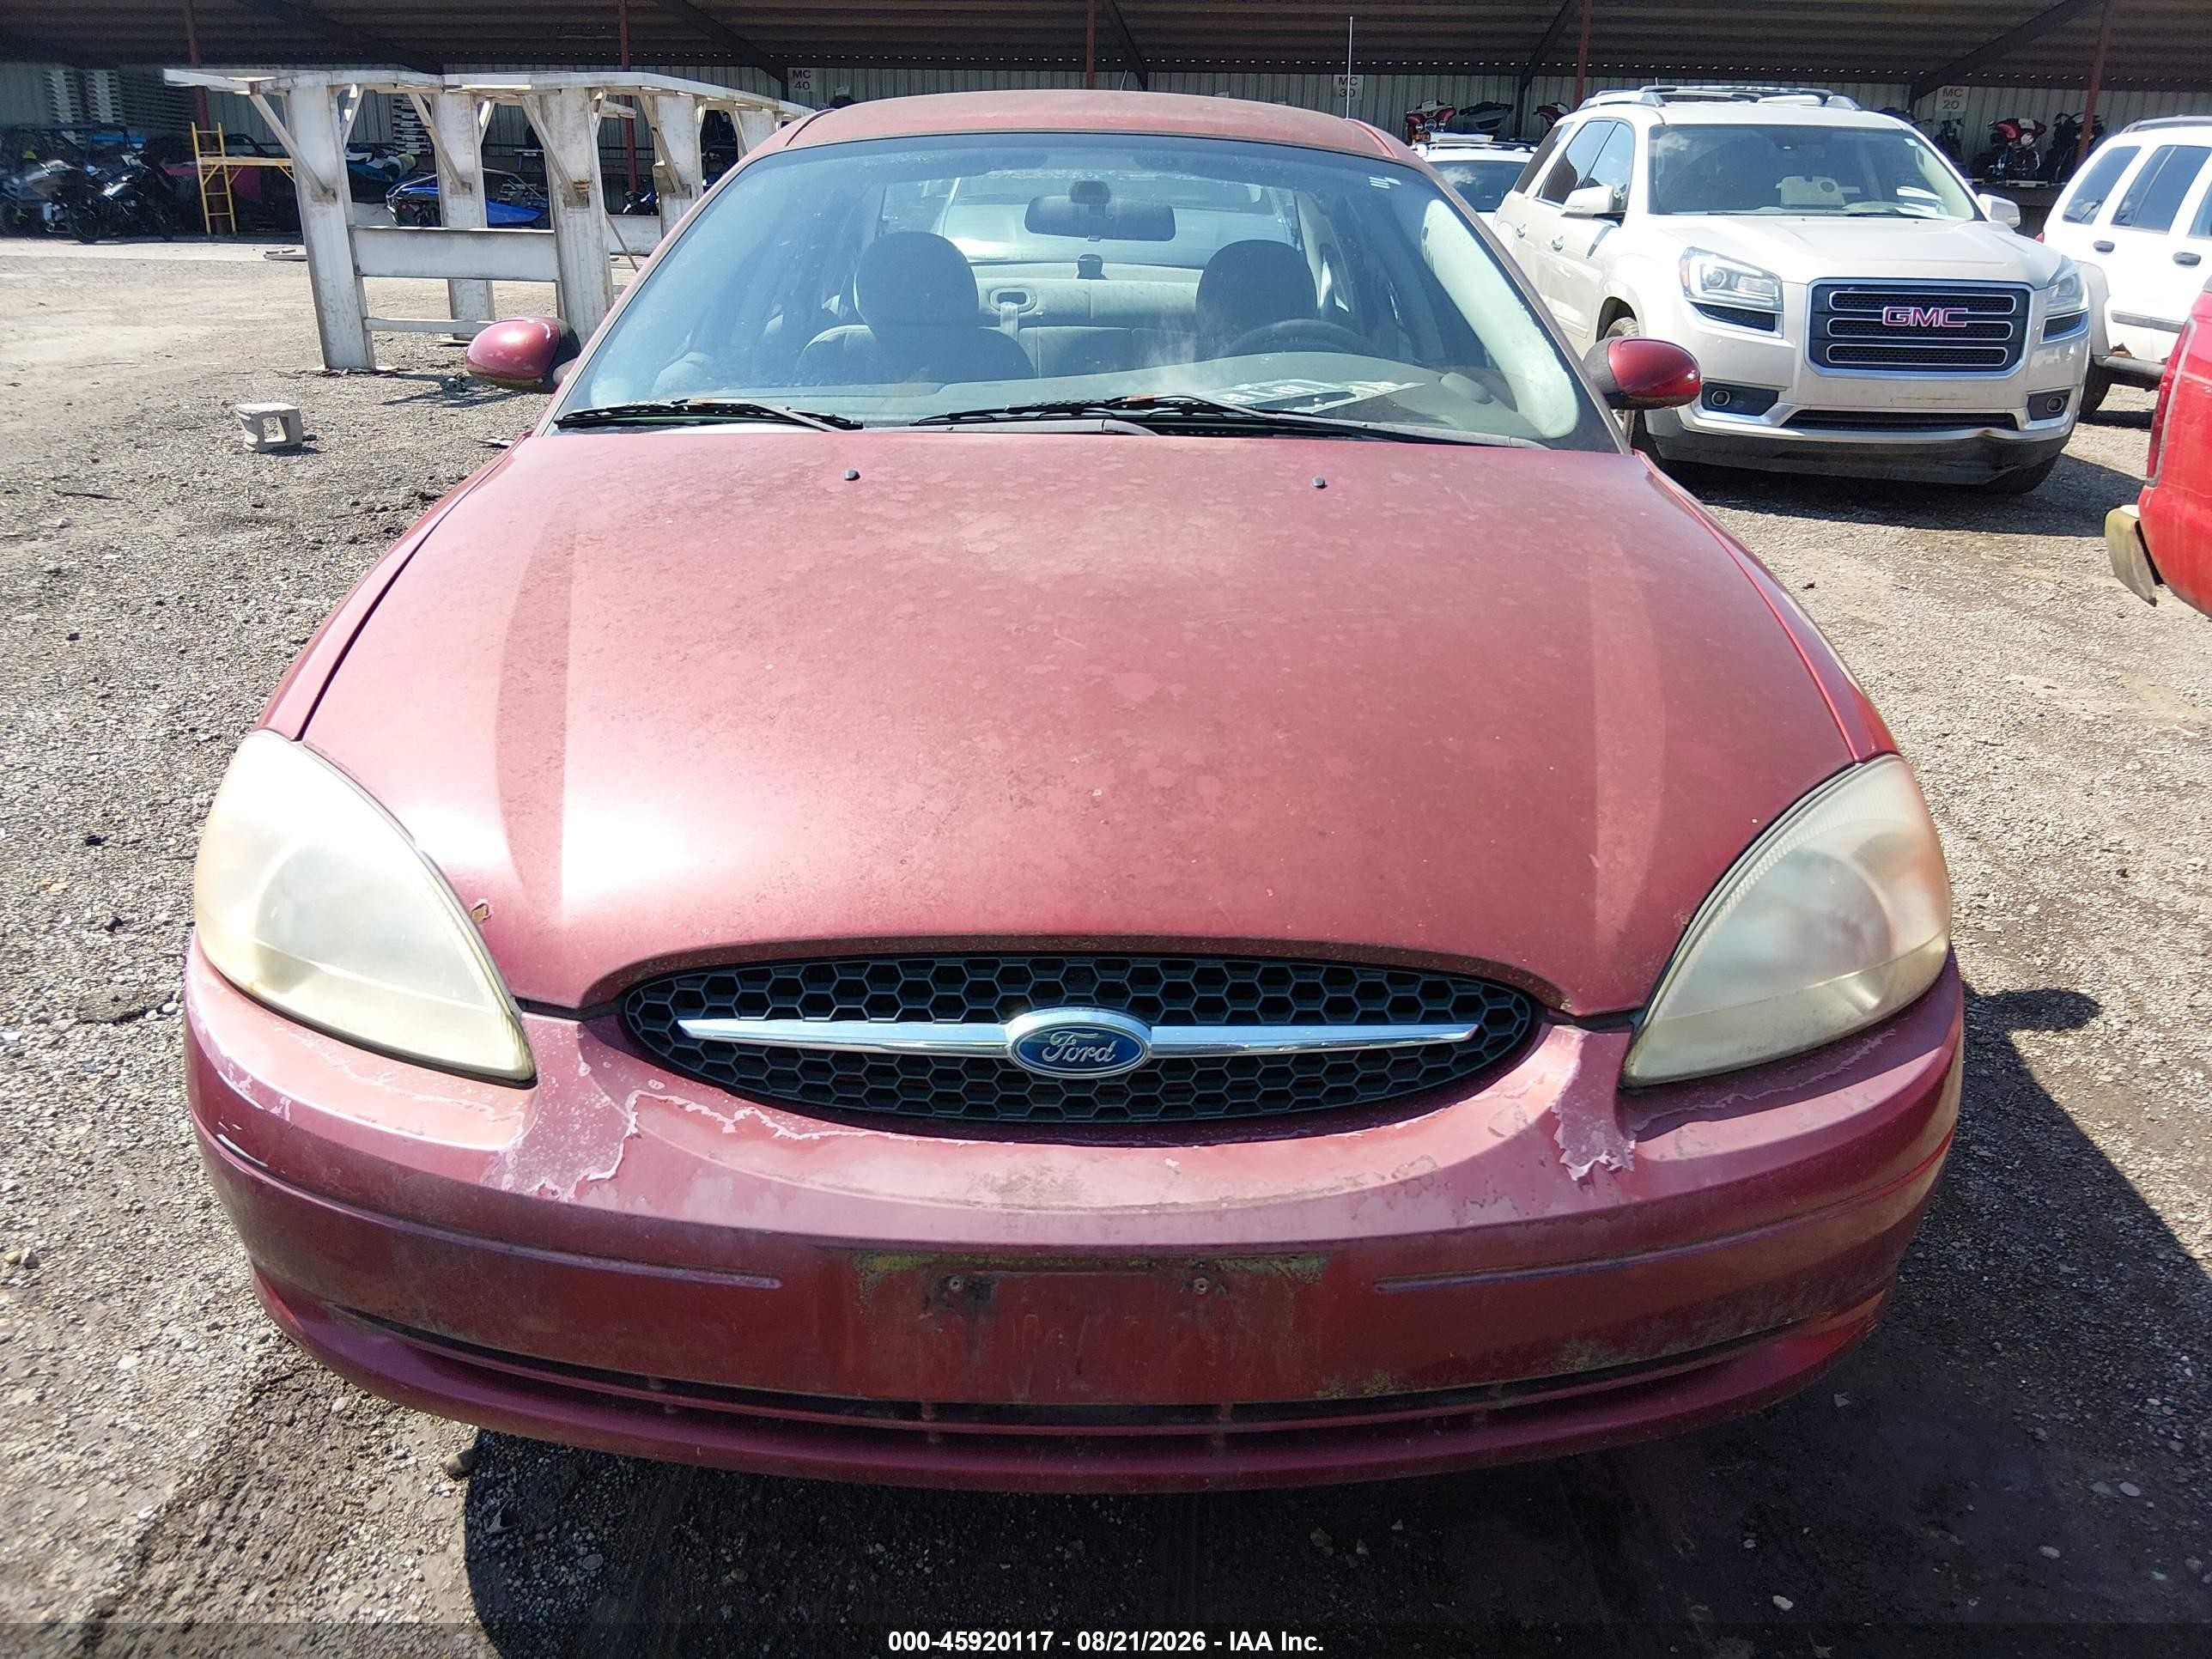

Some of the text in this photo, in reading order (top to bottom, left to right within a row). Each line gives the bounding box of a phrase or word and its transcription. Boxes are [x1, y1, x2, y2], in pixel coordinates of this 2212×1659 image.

[792, 70, 811, 79] MC
[794, 82, 811, 90] 40
[1338, 76, 1358, 86] MC
[1339, 88, 1356, 98] 30
[1942, 88, 1964, 98] MC
[1942, 100, 1960, 110] 20
[1882, 306, 1968, 327] GMC
[1042, 1030, 1117, 1062] Ford
